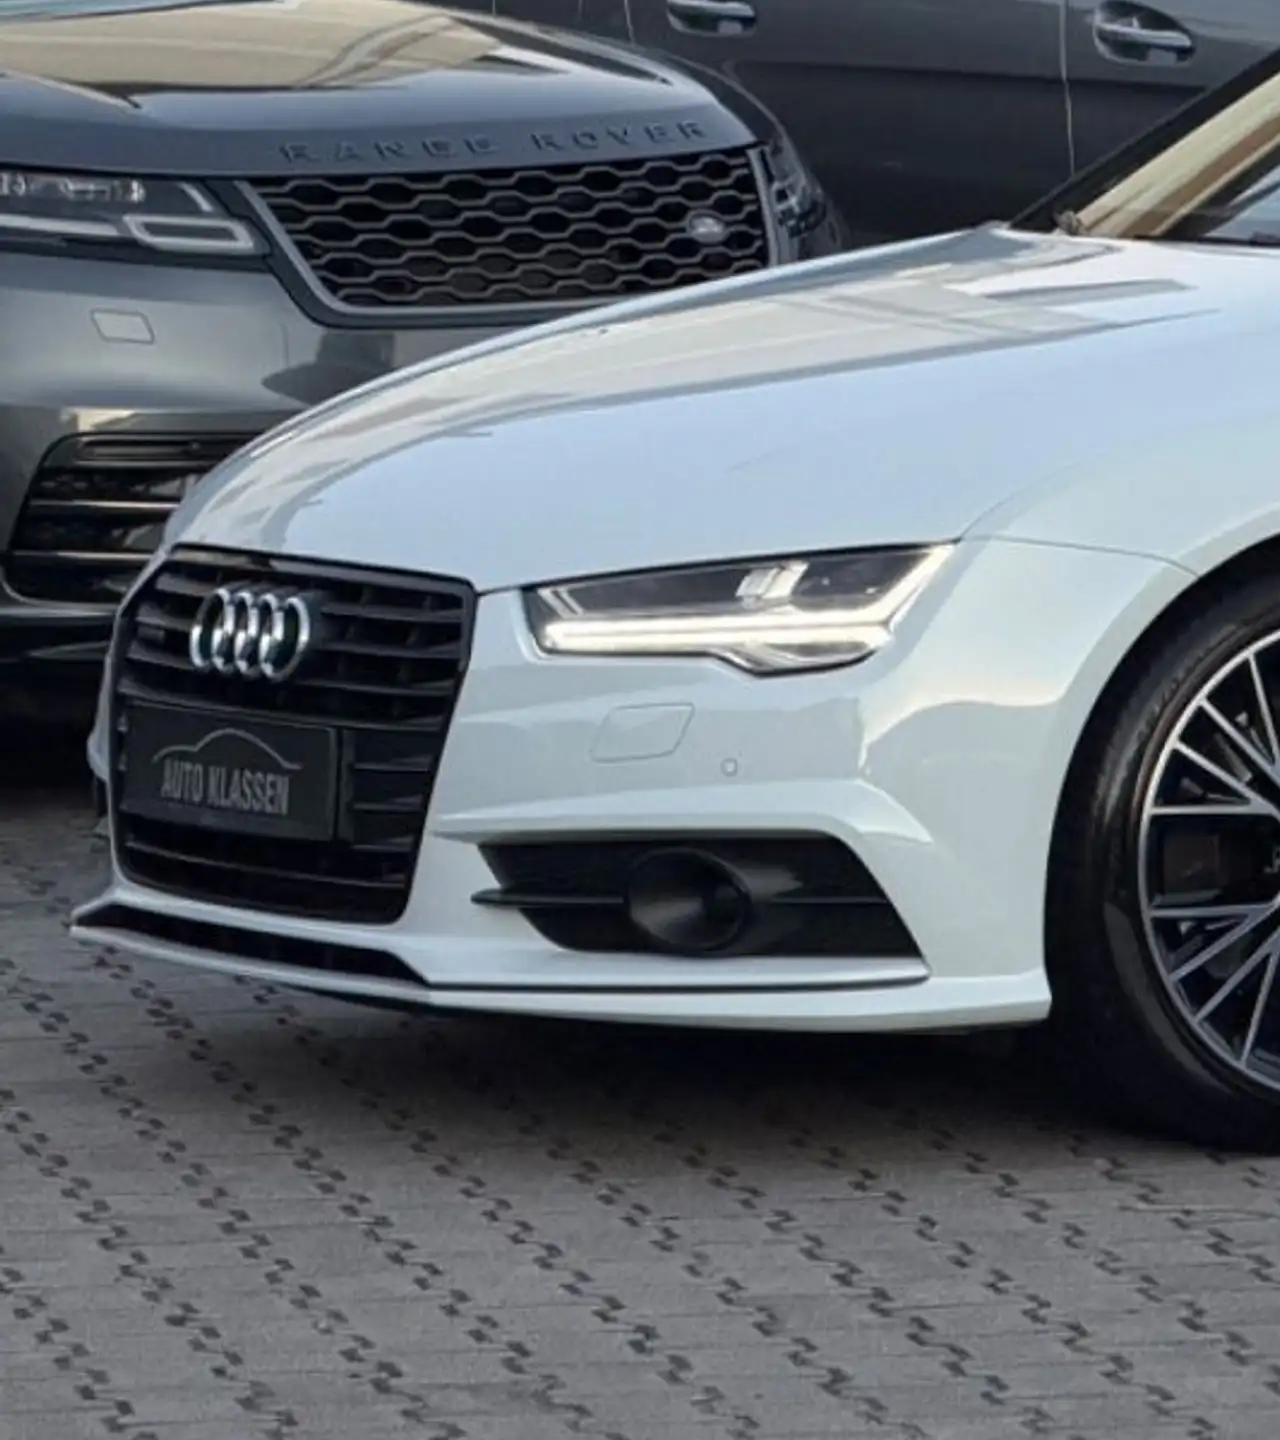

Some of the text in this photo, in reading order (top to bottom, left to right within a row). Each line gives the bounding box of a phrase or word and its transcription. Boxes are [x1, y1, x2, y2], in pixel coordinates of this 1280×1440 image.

[278, 119, 707, 163] RANGE ROVER
[160, 757, 290, 816] AUTO KLASSEN
